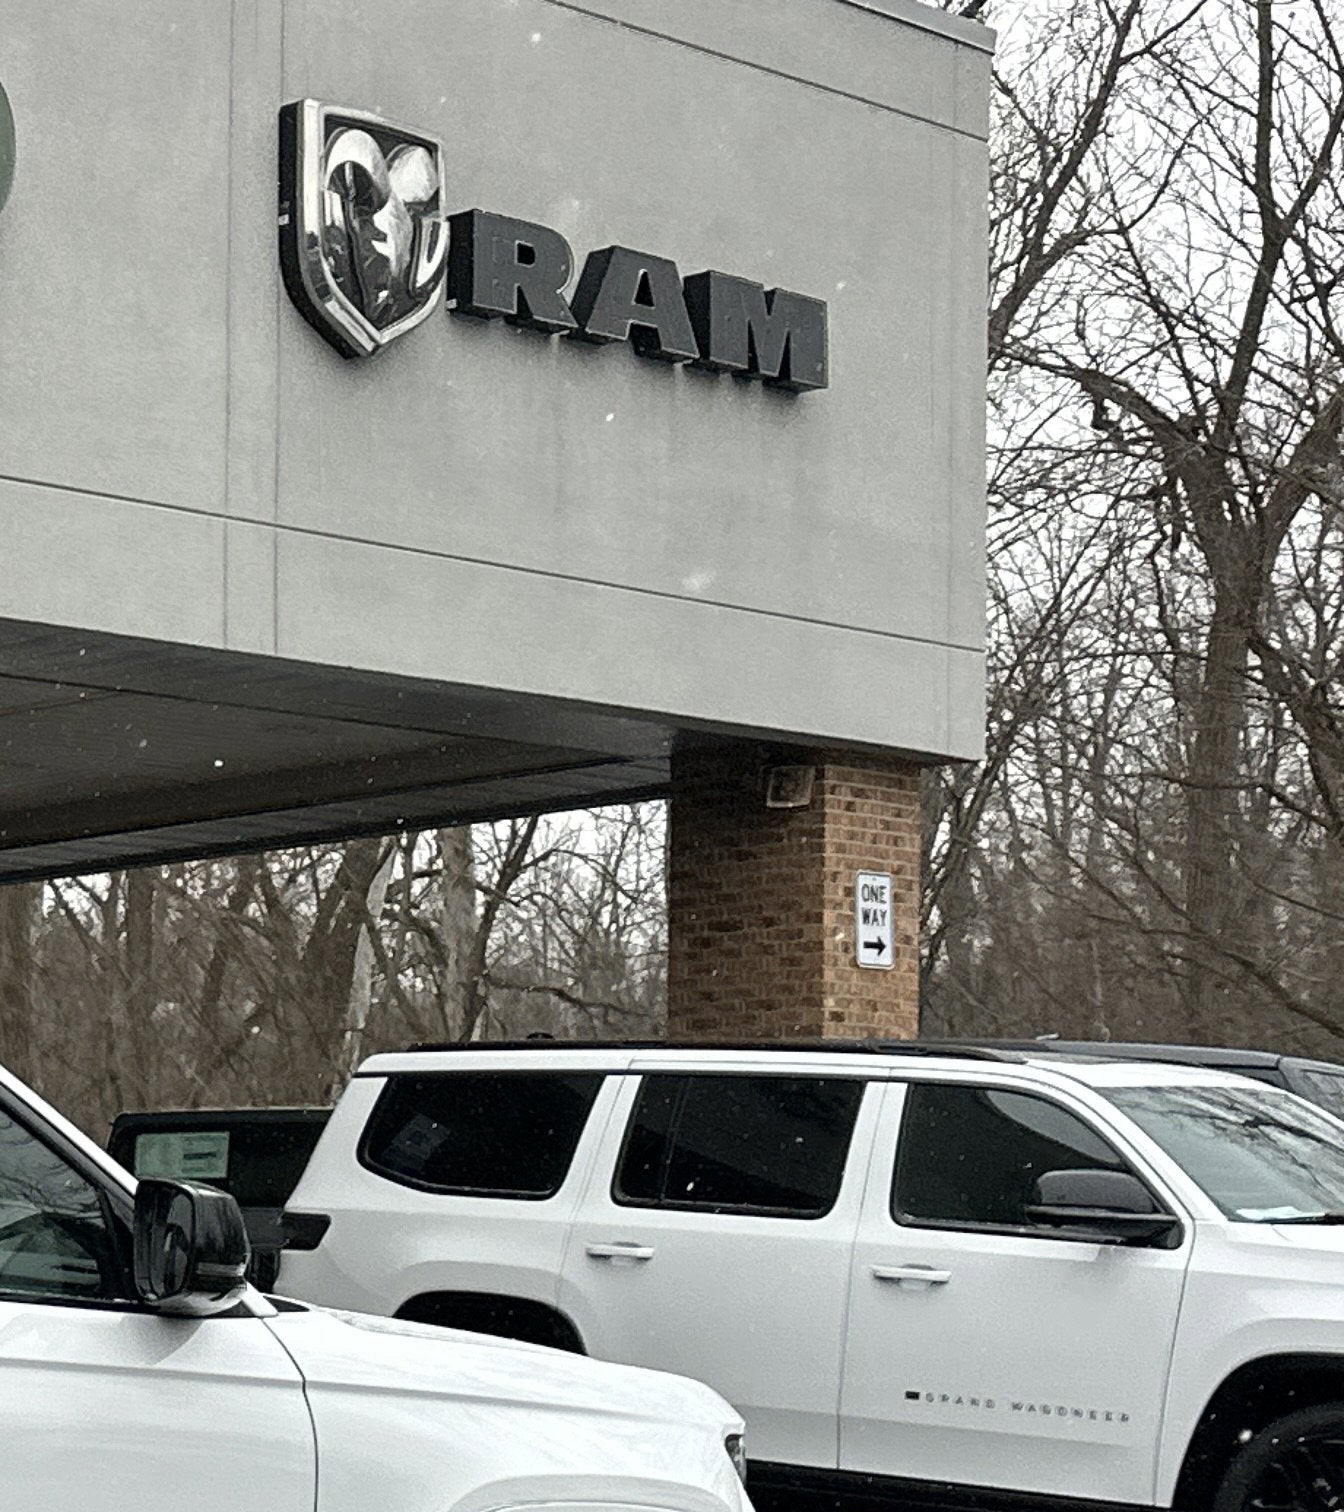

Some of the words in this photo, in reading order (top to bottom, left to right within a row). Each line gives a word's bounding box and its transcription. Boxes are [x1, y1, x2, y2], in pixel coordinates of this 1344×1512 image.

[446, 208, 829, 392] RAM
[861, 883, 888, 904] ONE
[861, 908, 888, 927] WAY
[925, 1392, 996, 1409] GRAND
[1011, 1401, 1131, 1423] WAGONEER
